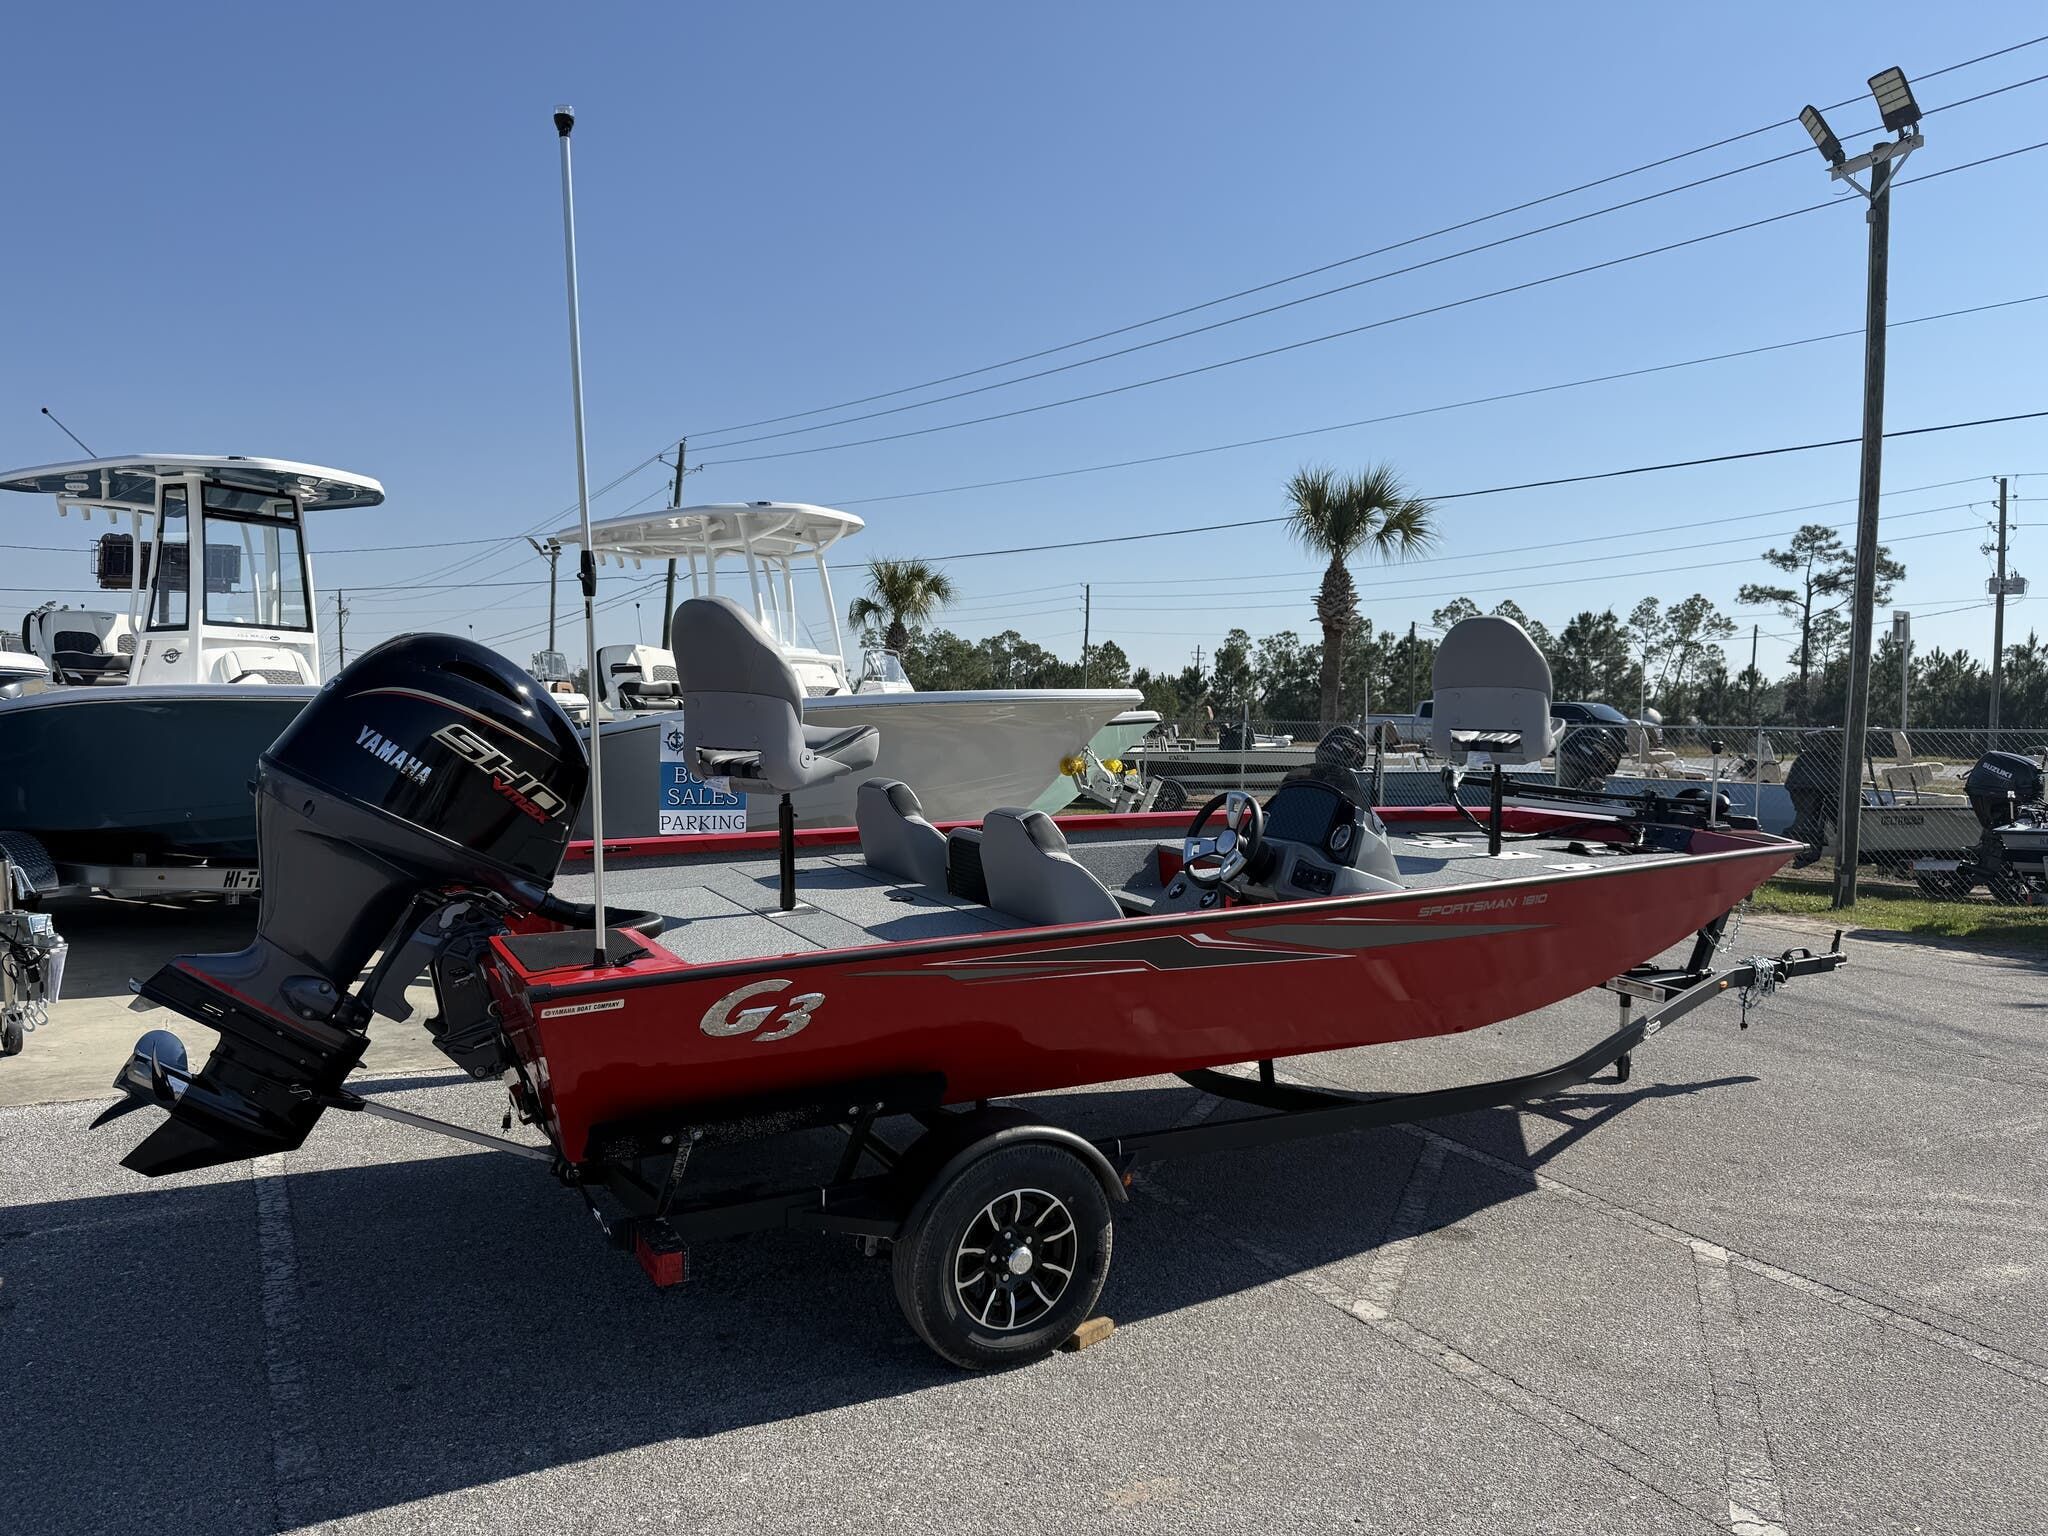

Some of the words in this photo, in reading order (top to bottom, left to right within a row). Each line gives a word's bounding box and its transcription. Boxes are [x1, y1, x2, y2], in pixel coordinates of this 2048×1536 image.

[356, 725, 432, 785] YAMAHA
[431, 724, 567, 818] SHO
[1982, 762, 2013, 779] SUZUKI
[668, 788, 738, 805] SALES
[660, 815, 745, 831] PARKING
[1418, 897, 1518, 917] SPORTSMAN
[1522, 893, 1548, 905] 1810
[552, 1007, 576, 1016] YAMAHA
[593, 1001, 620, 1010] COMPANY
[699, 979, 826, 1042] G3
